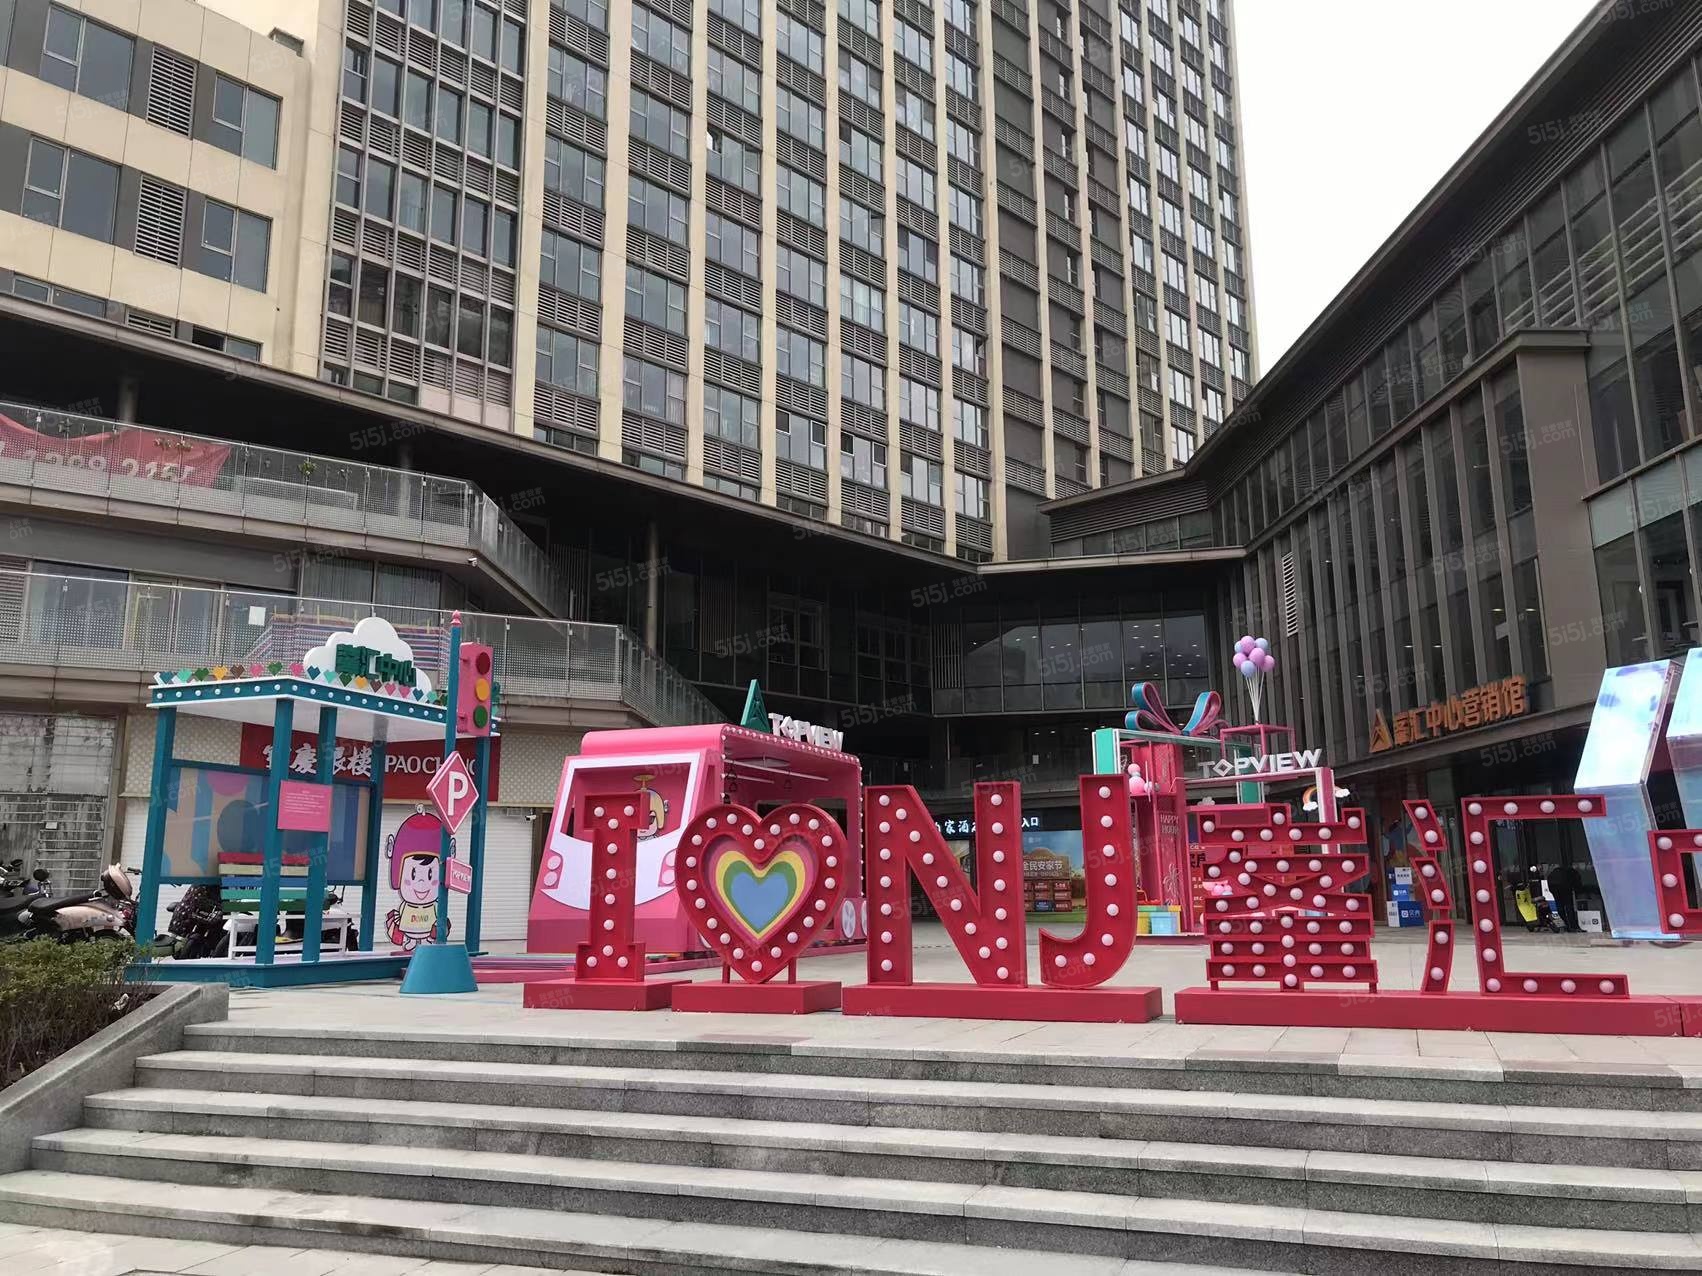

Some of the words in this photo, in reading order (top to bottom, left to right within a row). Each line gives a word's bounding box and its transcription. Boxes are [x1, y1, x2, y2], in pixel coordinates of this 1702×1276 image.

[768, 712, 844, 752] TOPVIEW
[1198, 749, 1322, 778] TOPVIEW
[447, 770, 468, 816] P
[1021, 816, 1039, 828] 入口
[864, 774, 1137, 990] NJ
